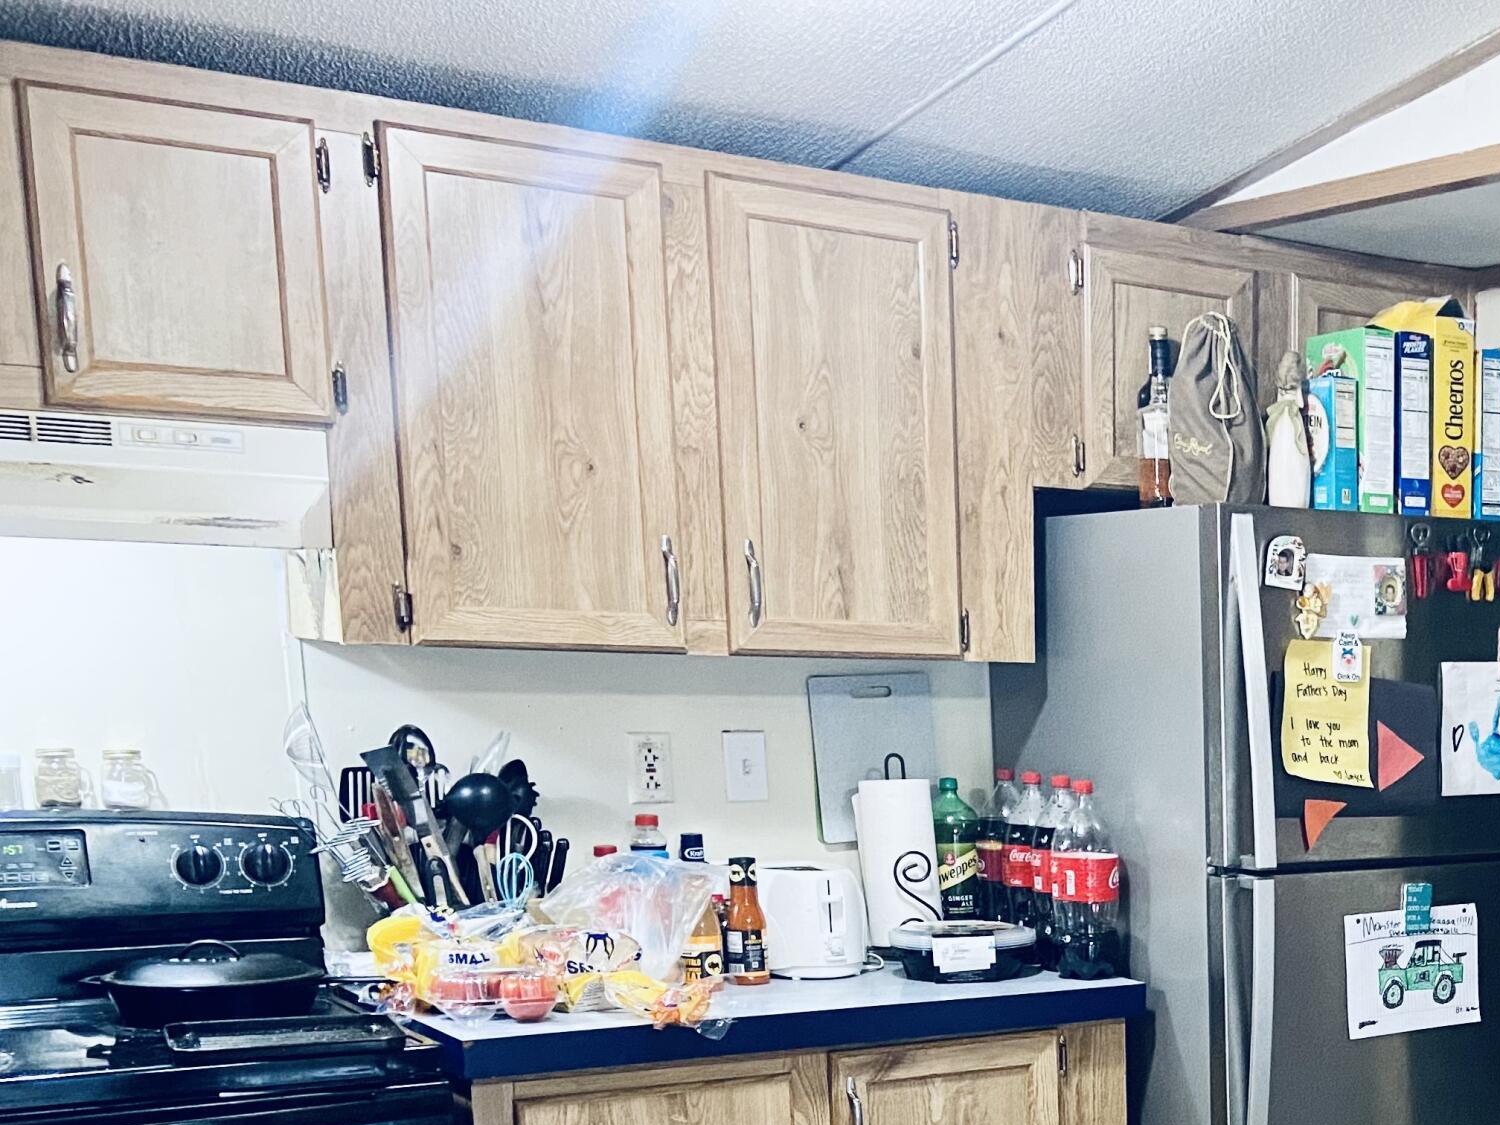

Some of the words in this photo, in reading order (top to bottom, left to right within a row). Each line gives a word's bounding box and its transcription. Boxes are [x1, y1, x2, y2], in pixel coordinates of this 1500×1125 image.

[1444, 359, 1465, 441] Cheerios
[1303, 662, 1327, 680] Happy
[1296, 684, 1329, 698] Father's
[1331, 685, 1347, 702] Day
[1305, 718, 1320, 731] love
[1326, 722, 1341, 736] you
[1300, 735, 1312, 747] to
[1319, 735, 1334, 748] the
[1291, 751, 1309, 764] and
[1318, 752, 1339, 765] back
